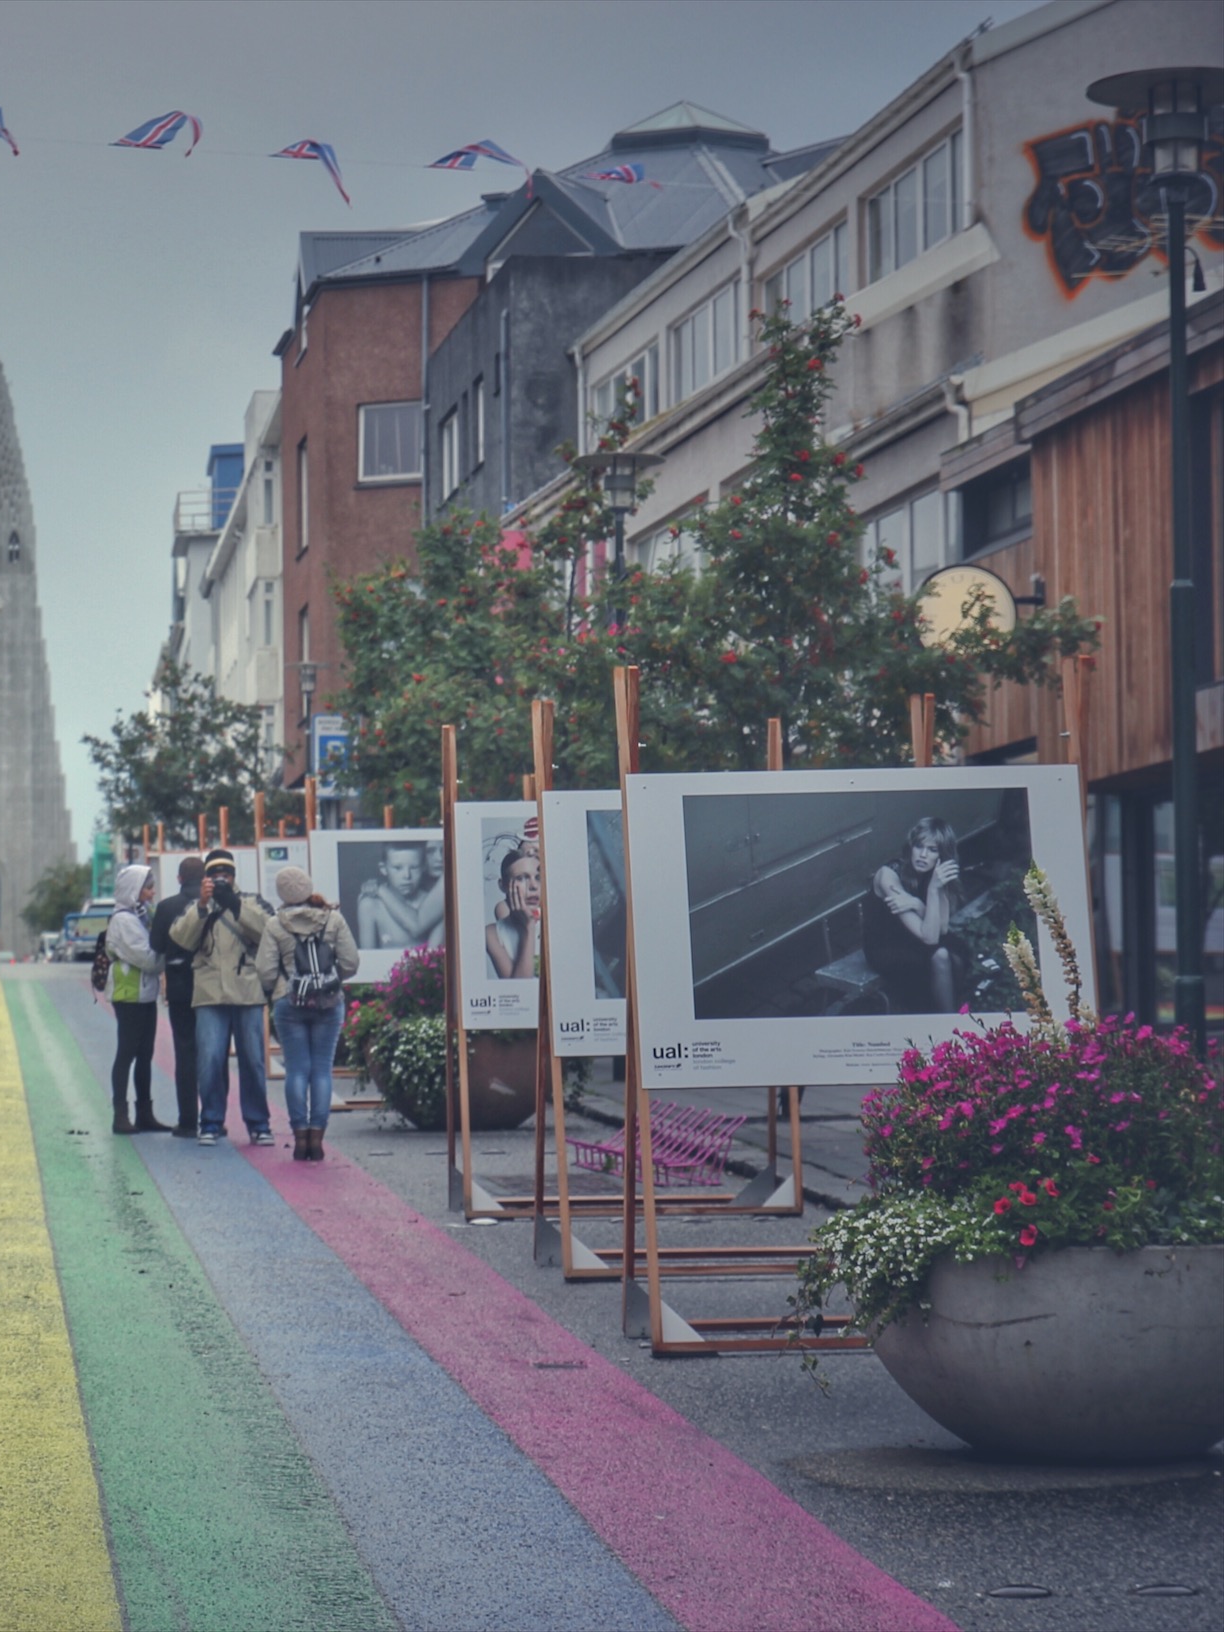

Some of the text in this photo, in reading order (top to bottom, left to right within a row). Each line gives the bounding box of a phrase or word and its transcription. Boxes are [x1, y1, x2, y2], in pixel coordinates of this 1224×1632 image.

[470, 995, 496, 1007] ual:
[560, 1018, 590, 1032] ual:
[653, 1043, 689, 1059] ual:
